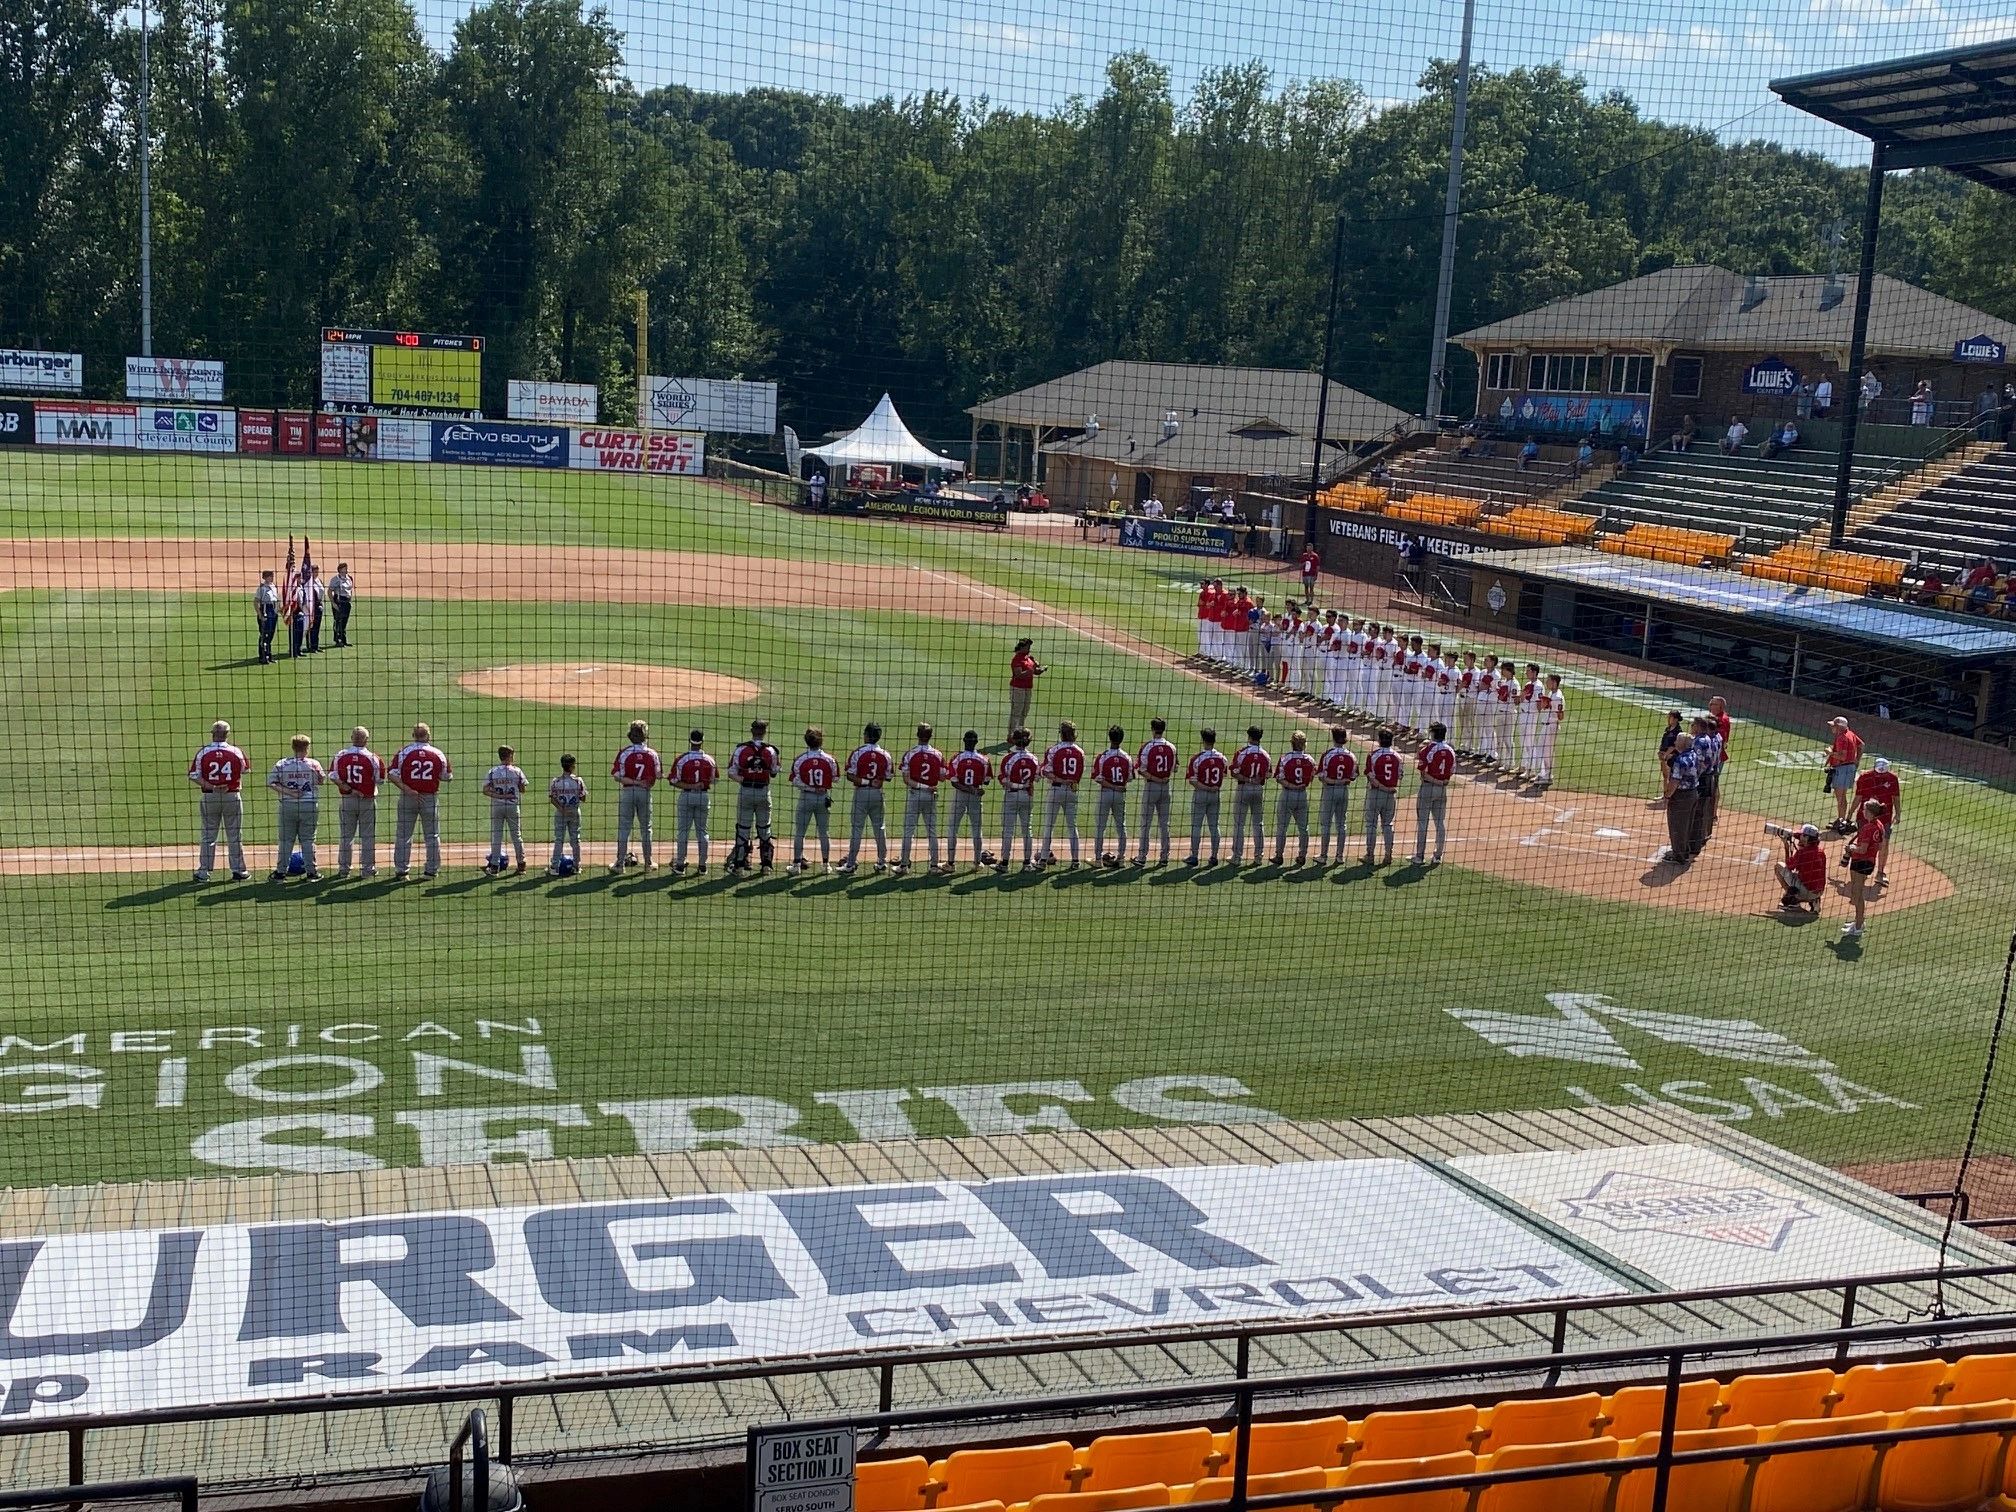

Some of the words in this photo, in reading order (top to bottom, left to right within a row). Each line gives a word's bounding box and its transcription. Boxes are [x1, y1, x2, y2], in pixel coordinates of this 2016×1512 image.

[396, 334, 419, 346] 4:00
[473, 338, 480, 350] 0
[1961, 342, 2000, 358] LOWE'S
[1749, 366, 1793, 389] LOWE'S
[539, 394, 590, 407] BAYADA
[657, 393, 691, 402] WORLD
[657, 401, 690, 409] SERIES
[57, 418, 113, 440] MAM
[242, 425, 273, 435] SPEAKER
[290, 426, 302, 435] TIM
[452, 431, 498, 442] SERVO
[501, 433, 548, 444] SOUTH
[137, 432, 192, 445] Cleveland
[195, 434, 234, 447] County
[599, 450, 693, 472] WRIGHT
[864, 500, 908, 513] AMERICAN
[909, 505, 940, 517] LEGION
[941, 507, 973, 520] WORLD
[974, 510, 1006, 523] SERIES
[1171, 526, 1193, 536] USAA
[1193, 527, 1201, 537] IS
[1201, 529, 1208, 538] A
[1329, 518, 1377, 543] VETERANS
[1426, 537, 1471, 559] KEETER
[1153, 532, 1180, 544] PROUD
[1180, 534, 1225, 553] SUPPORTER
[208, 760, 233, 782] 24
[410, 760, 433, 781] 22
[635, 763, 645, 779] 7
[868, 763, 877, 779] 3
[920, 763, 930, 779] 2
[1061, 758, 1077, 775] 19
[1155, 755, 1168, 772] 21
[1336, 764, 1344, 780] 6
[1383, 763, 1393, 781] 5
[345, 765, 363, 784] 15
[693, 769, 701, 783] 1
[807, 769, 824, 786] 19
[964, 769, 974, 786] 8
[1204, 767, 1220, 784] 13
[1294, 767, 1302, 783] 9
[1586, 1192, 1767, 1211] WORLD
[1609, 1202, 1779, 1221] SERIES
[846, 1262, 1563, 1338] CHEVROLET
[248, 1322, 739, 1387] RAM
[0, 1374, 89, 1415] P
[773, 1440, 801, 1461] BOX
[805, 1436, 840, 1458] SEAT
[767, 1459, 827, 1484] SECTION
[830, 1457, 843, 1477] JJ
[771, 1493, 788, 1503] BOX
[788, 1490, 807, 1501] SEAT
[808, 1487, 840, 1498] DONORS
[775, 1503, 804, 1512] SERVO
[806, 1500, 836, 1512] SOUTH
